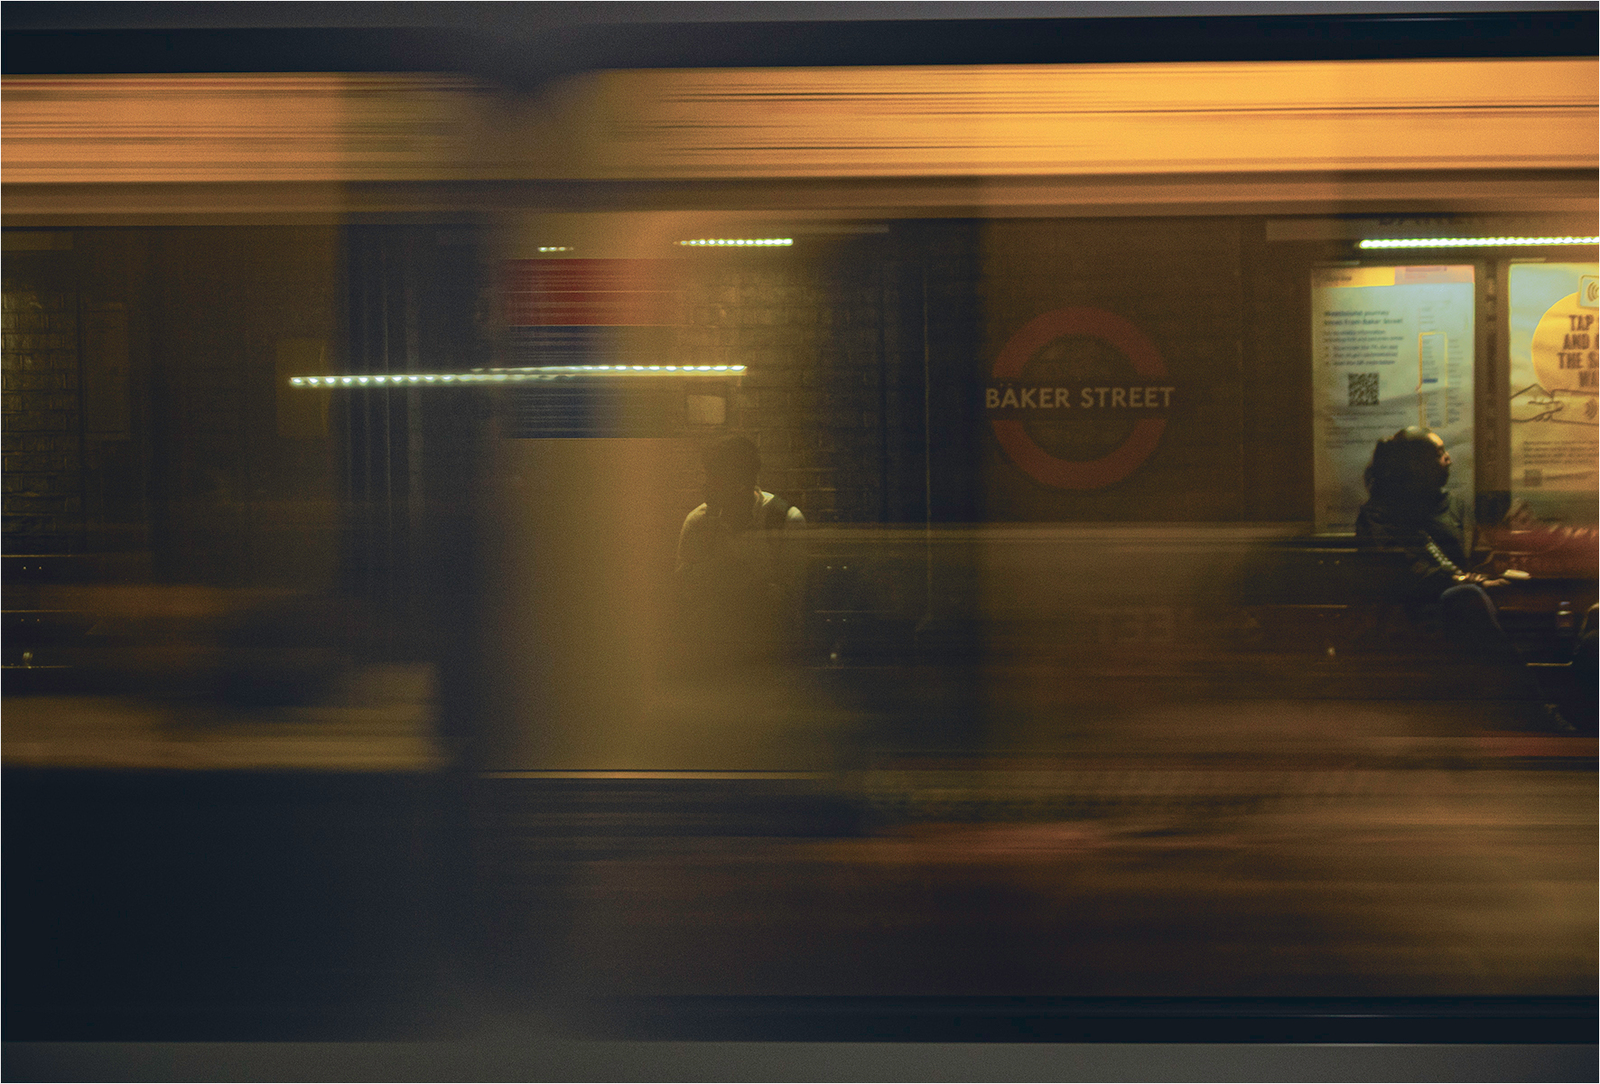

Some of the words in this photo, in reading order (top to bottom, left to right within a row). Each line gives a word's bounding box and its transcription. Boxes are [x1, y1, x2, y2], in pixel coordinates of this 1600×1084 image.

[1569, 314, 1594, 331] TAP
[1563, 333, 1590, 350] AND
[1558, 351, 1583, 369] THE
[985, 387, 1071, 409] BAKER
[1080, 386, 1176, 408] STREET
